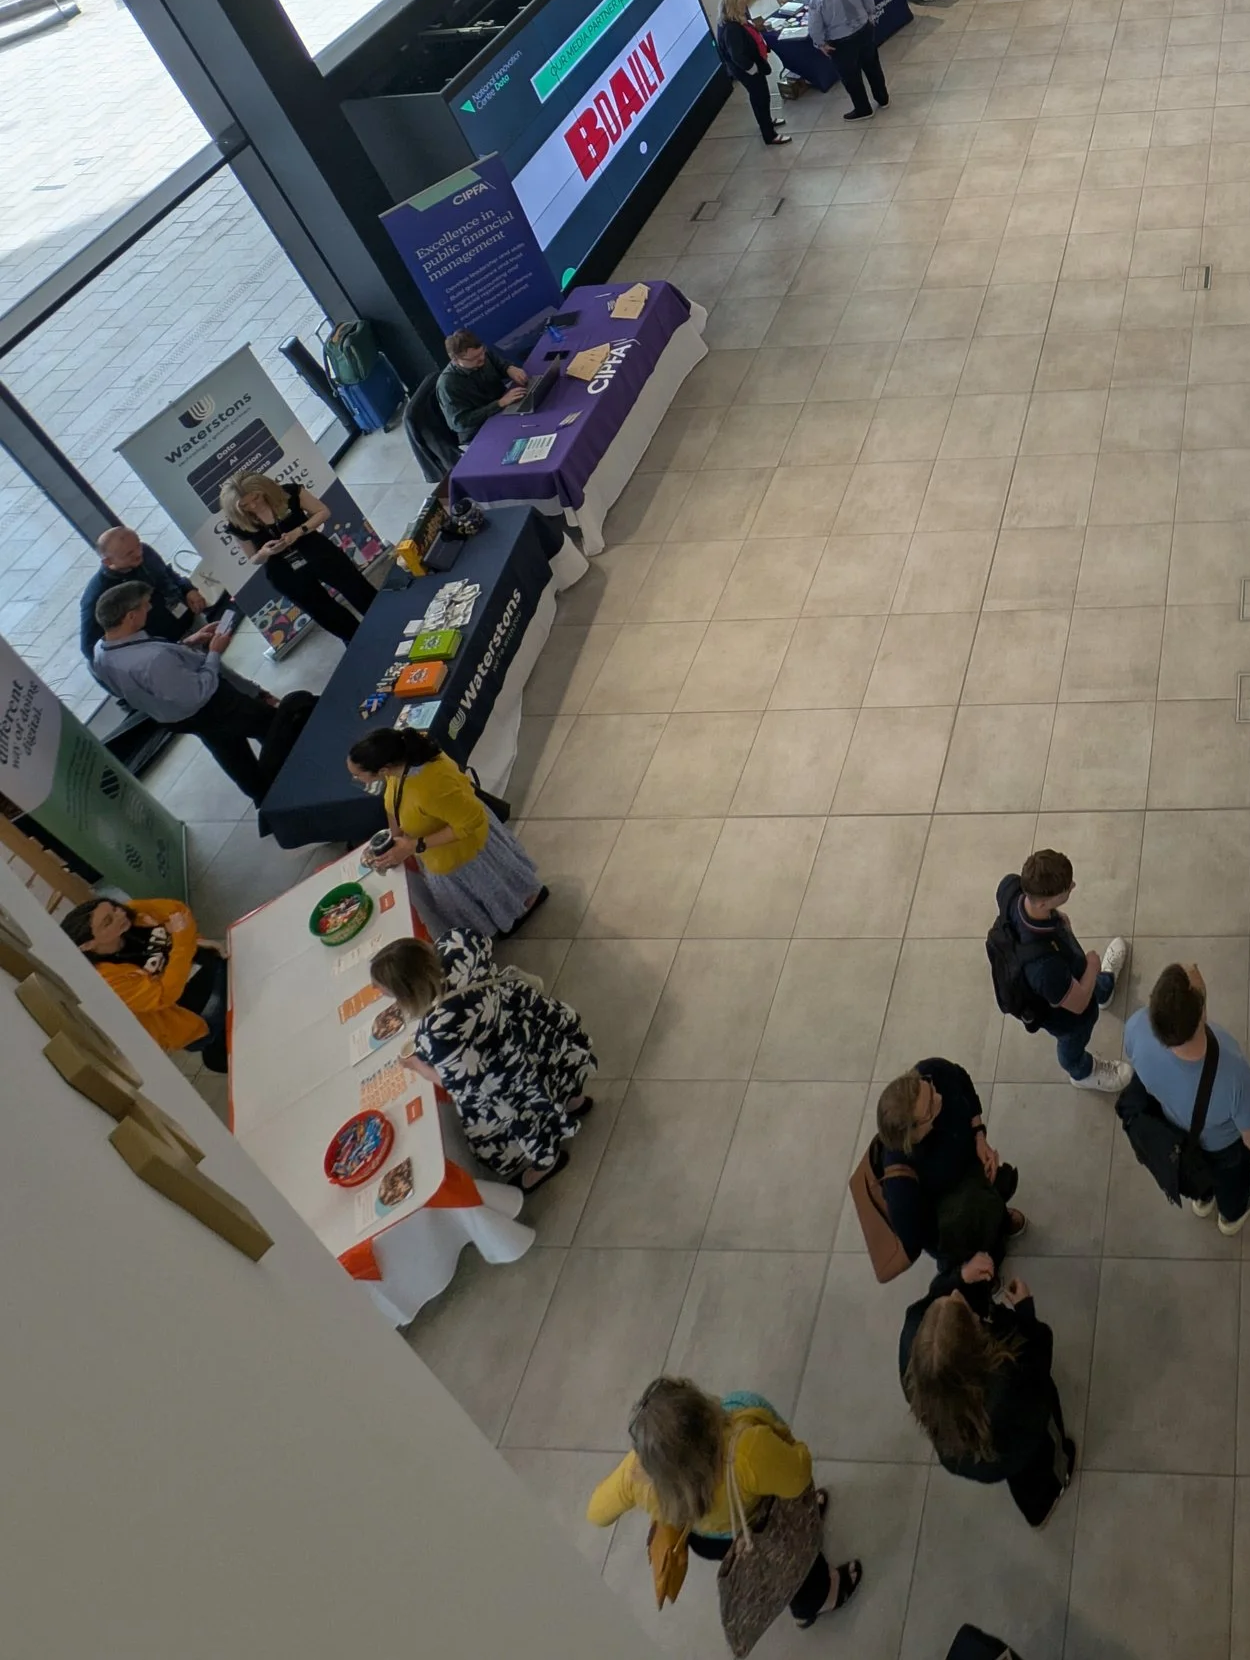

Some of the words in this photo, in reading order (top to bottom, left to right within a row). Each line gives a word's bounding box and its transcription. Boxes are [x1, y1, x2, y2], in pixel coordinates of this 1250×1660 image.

[550, 55, 568, 78] OUR
[567, 32, 590, 58] MEDIA
[587, 0, 618, 38] PARTNER
[472, 75, 496, 102] National
[494, 50, 522, 79] Innovation
[476, 88, 496, 110] Centre
[494, 74, 510, 91] Data
[563, 30, 665, 182] BDAILY
[453, 183, 489, 205] CIPFA
[415, 217, 480, 260] Excellence
[481, 209, 495, 221] in
[422, 243, 461, 273] public
[461, 210, 515, 247] financial
[428, 230, 506, 283] management
[587, 343, 632, 395] CIPFA
[164, 392, 252, 464] Waterstons
[216, 442, 236, 460] Data
[229, 455, 239, 466] AI
[274, 458, 300, 483] our
[460, 588, 522, 709] Waterstons
[20, 680, 40, 723] doing
